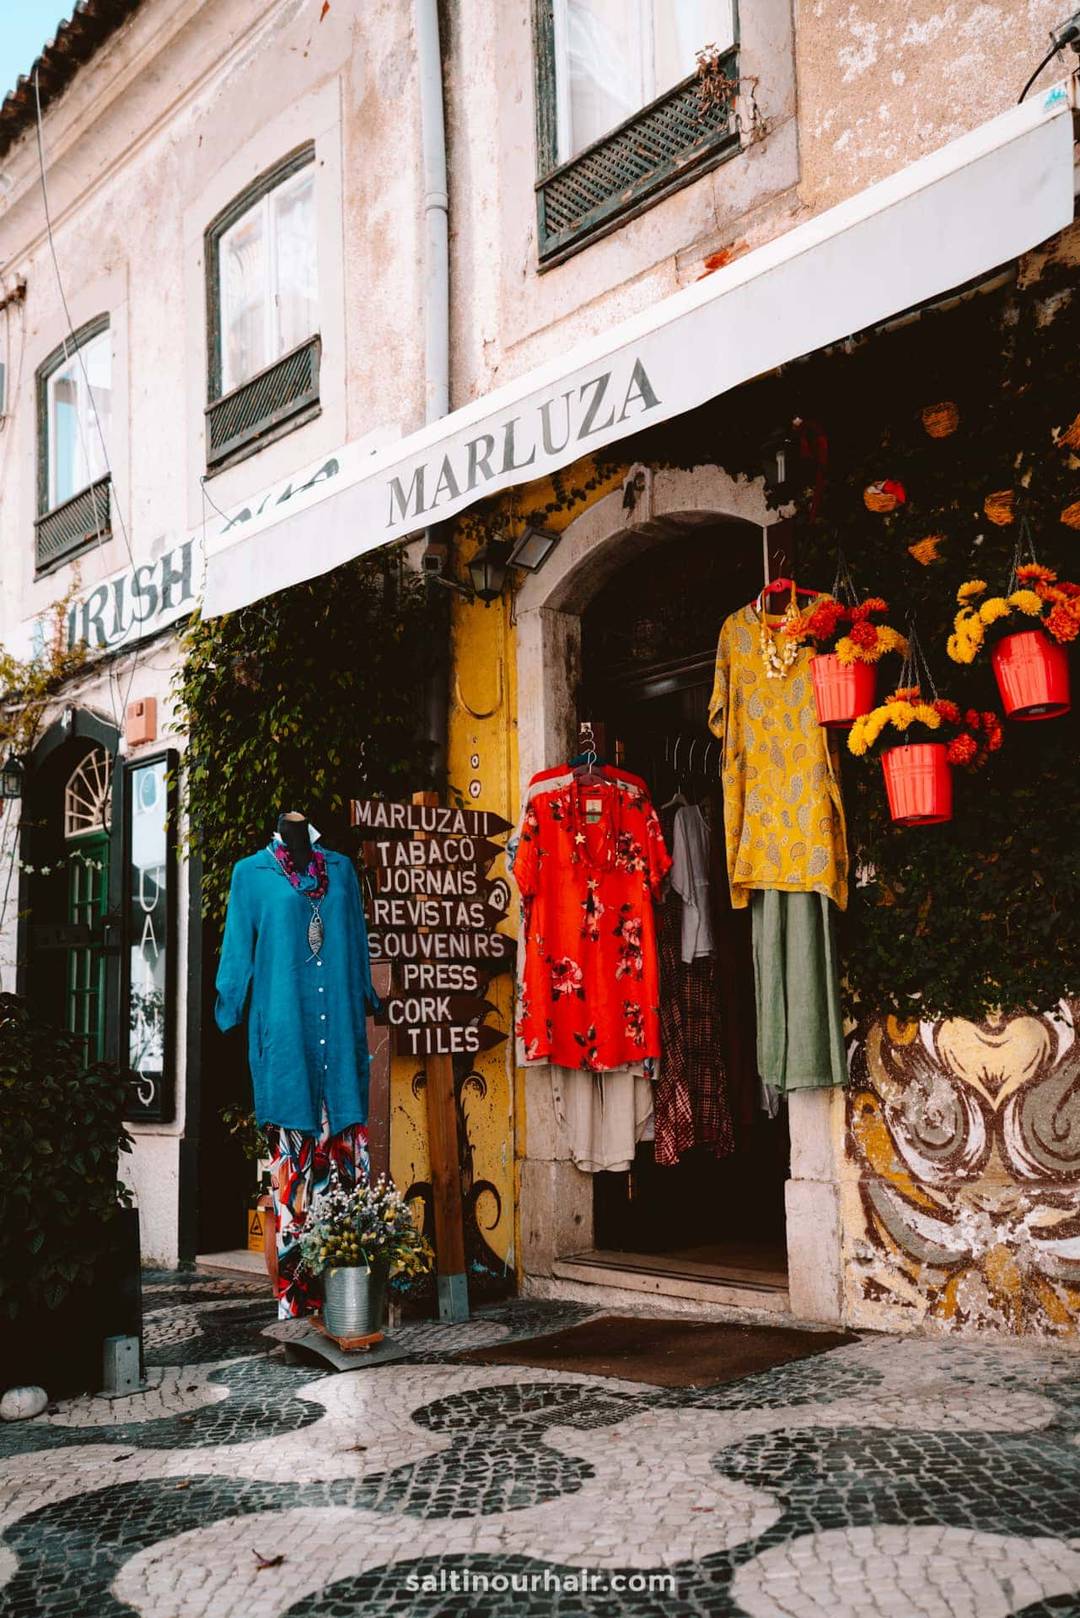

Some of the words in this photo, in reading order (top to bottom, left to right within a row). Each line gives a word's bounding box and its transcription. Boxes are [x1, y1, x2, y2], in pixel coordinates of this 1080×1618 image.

[385, 356, 662, 528] MARLUZA
[66, 537, 195, 651] IRISH
[355, 800, 467, 835] MARLUZA
[380, 868, 477, 895] JORNAIS
[374, 900, 485, 928] REVISTAS
[368, 932, 504, 958] SOUVENIRS
[404, 965, 478, 990] PRESS
[388, 997, 452, 1025] CORK
[408, 1027, 479, 1054] TILES
